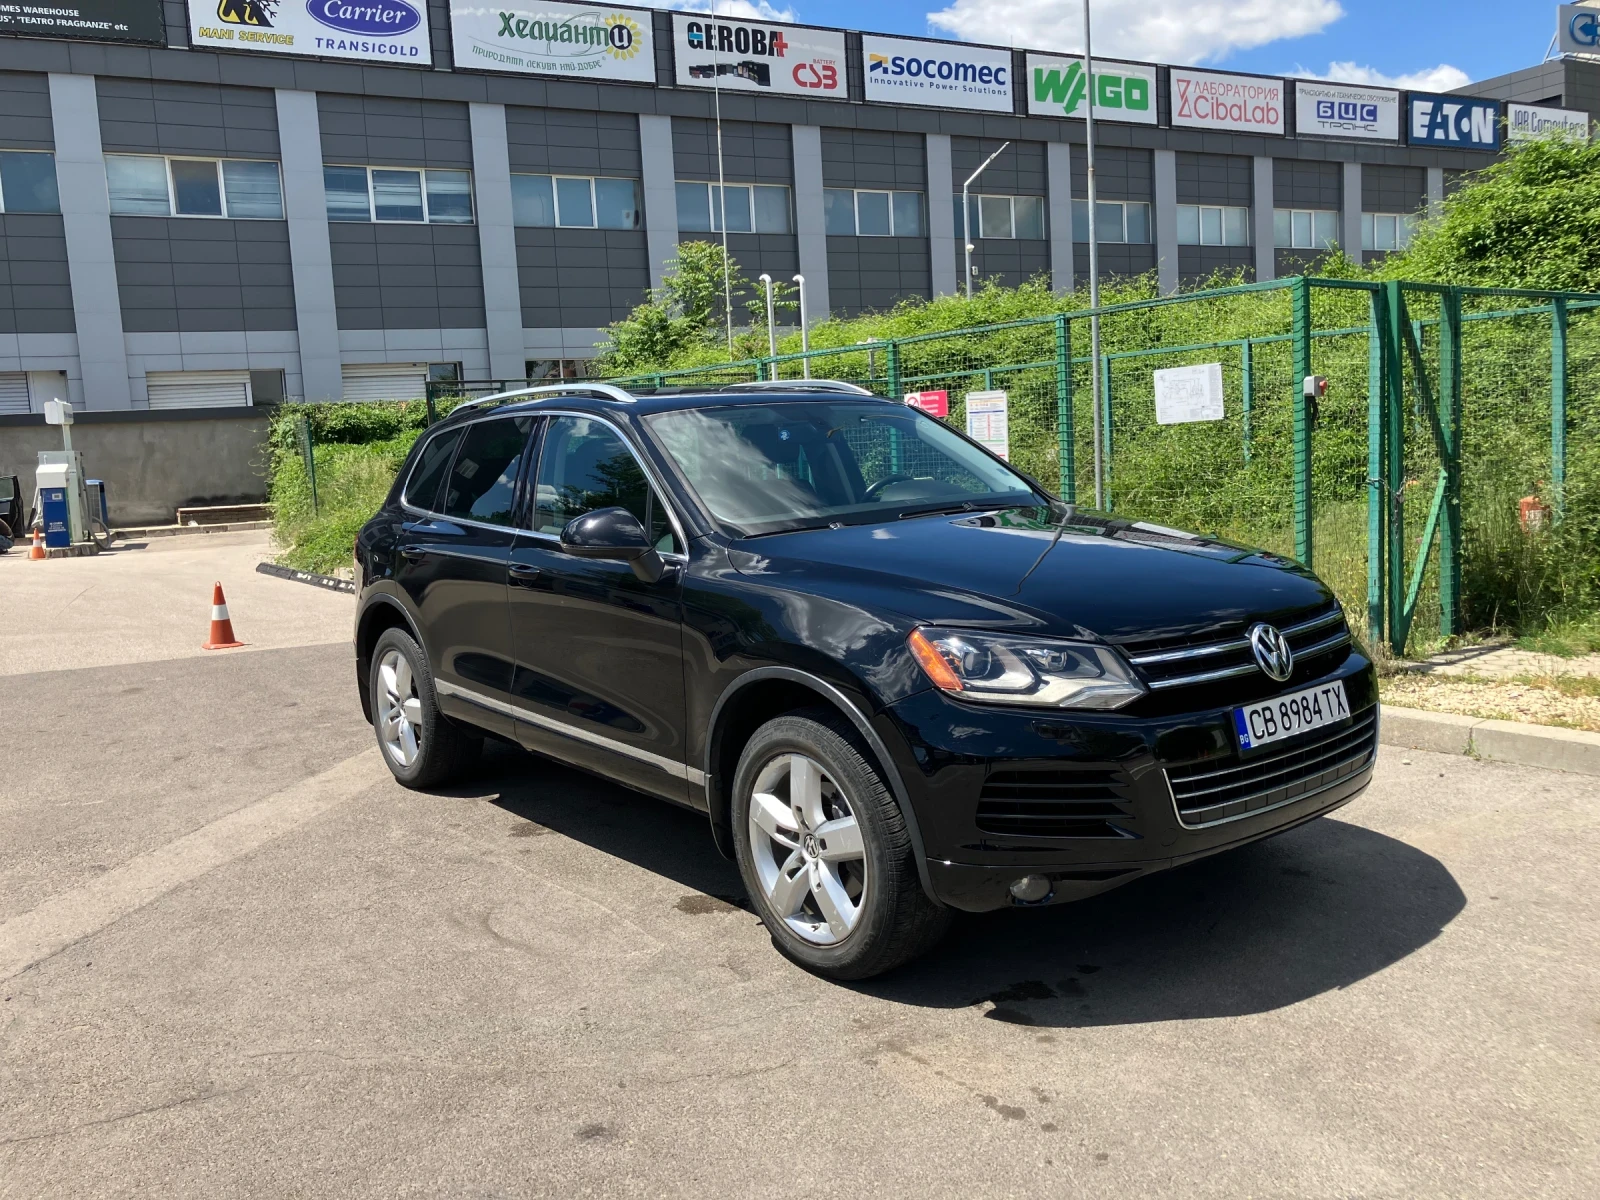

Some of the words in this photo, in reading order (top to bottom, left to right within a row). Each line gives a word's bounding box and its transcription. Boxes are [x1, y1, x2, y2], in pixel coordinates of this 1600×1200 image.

[23, 6, 79, 17] WAREHOUSE
[324, 0, 406, 23] Carrier
[114, 23, 128, 31] etc
[199, 27, 234, 40] MANI
[239, 30, 294, 45] SERVICE
[315, 37, 419, 57] TRANSICOLD
[813, 58, 836, 66] BATTERY
[891, 56, 1007, 86] socomec
[792, 63, 838, 89] CSB
[870, 77, 925, 88] Innovative
[929, 81, 958, 91] Power
[962, 85, 1007, 96] Solutions
[1034, 60, 1149, 114] WAGO
[1193, 80, 1279, 101] ЛАБОРАТОРИЯ
[1194, 95, 1279, 125] CibaLab
[1413, 100, 1494, 144] EATON
[1239, 733, 1249, 745] BG
[1249, 706, 1278, 740] CB
[1279, 692, 1323, 732] 8984
[1321, 685, 1346, 718] TX
